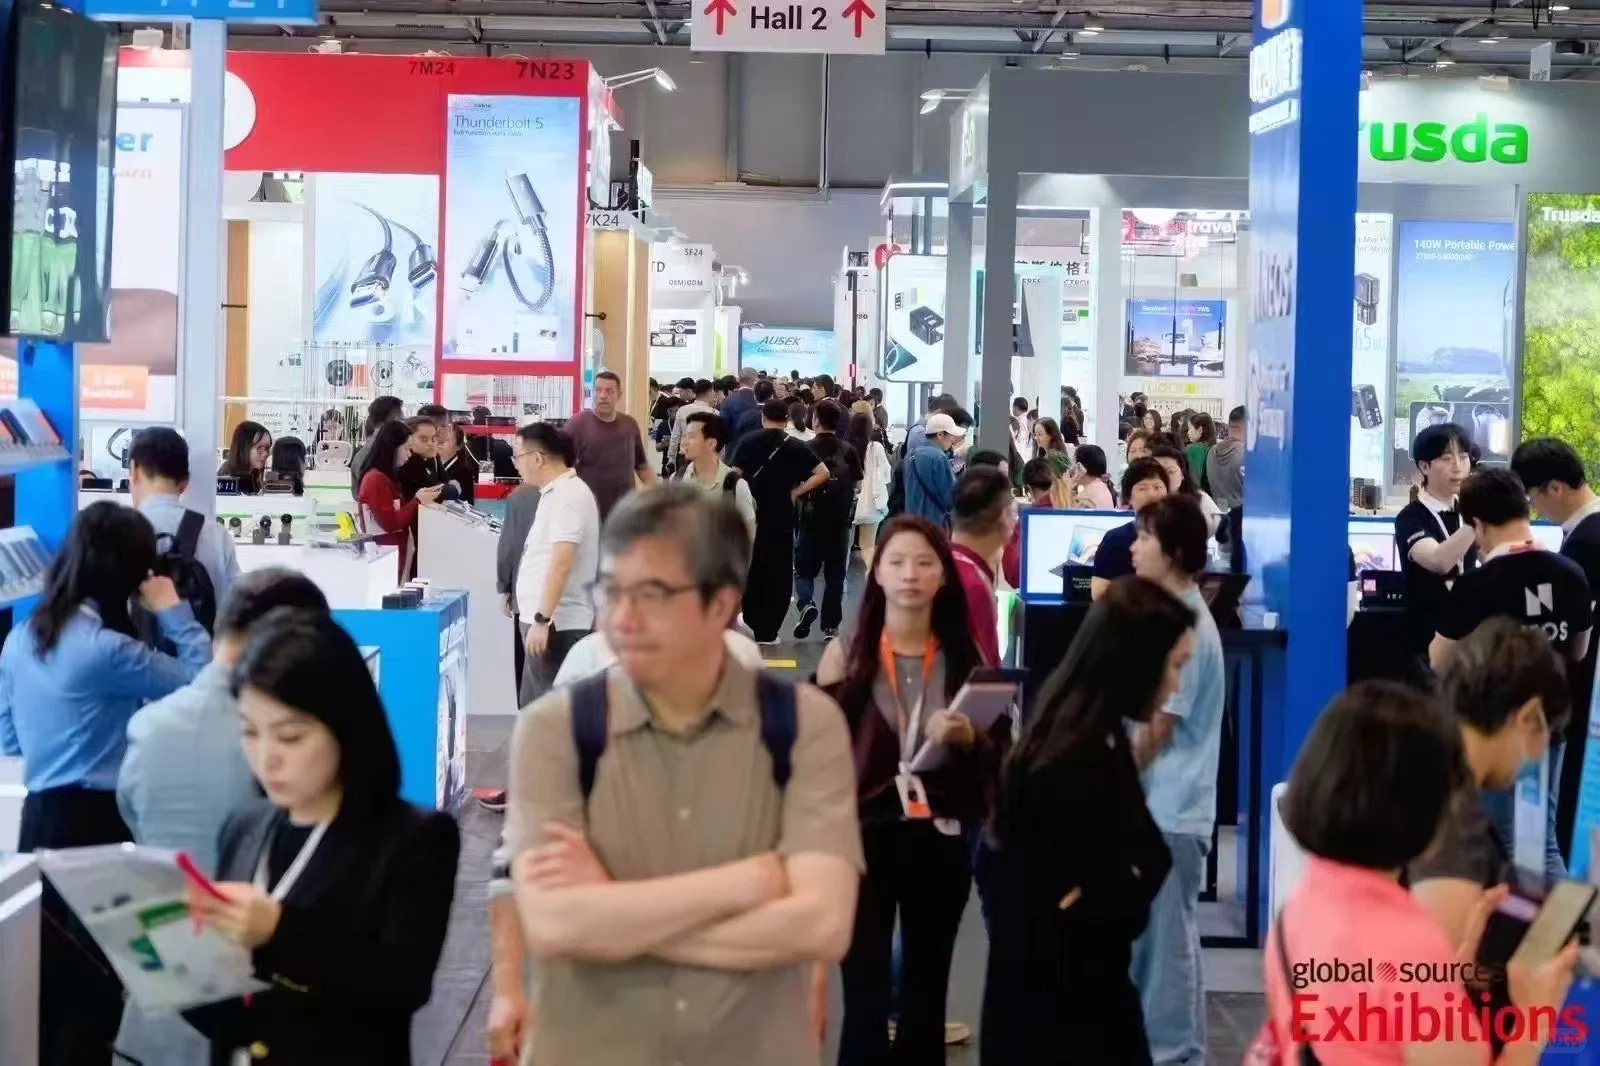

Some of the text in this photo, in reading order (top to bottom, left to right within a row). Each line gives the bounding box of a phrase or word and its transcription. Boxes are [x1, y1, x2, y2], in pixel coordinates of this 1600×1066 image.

[750, 5, 828, 30] Hall 2
[408, 60, 456, 76] 7M24
[515, 61, 575, 81] 7N23
[454, 115, 544, 130] Thunderbolt 5
[586, 213, 620, 227] 7K24
[1414, 239, 1442, 249] 140W
[1444, 239, 1486, 251] Portable
[668, 279, 703, 287] OEM/ODM
[759, 335, 801, 346] AUSEK
[1524, 582, 1554, 617] N
